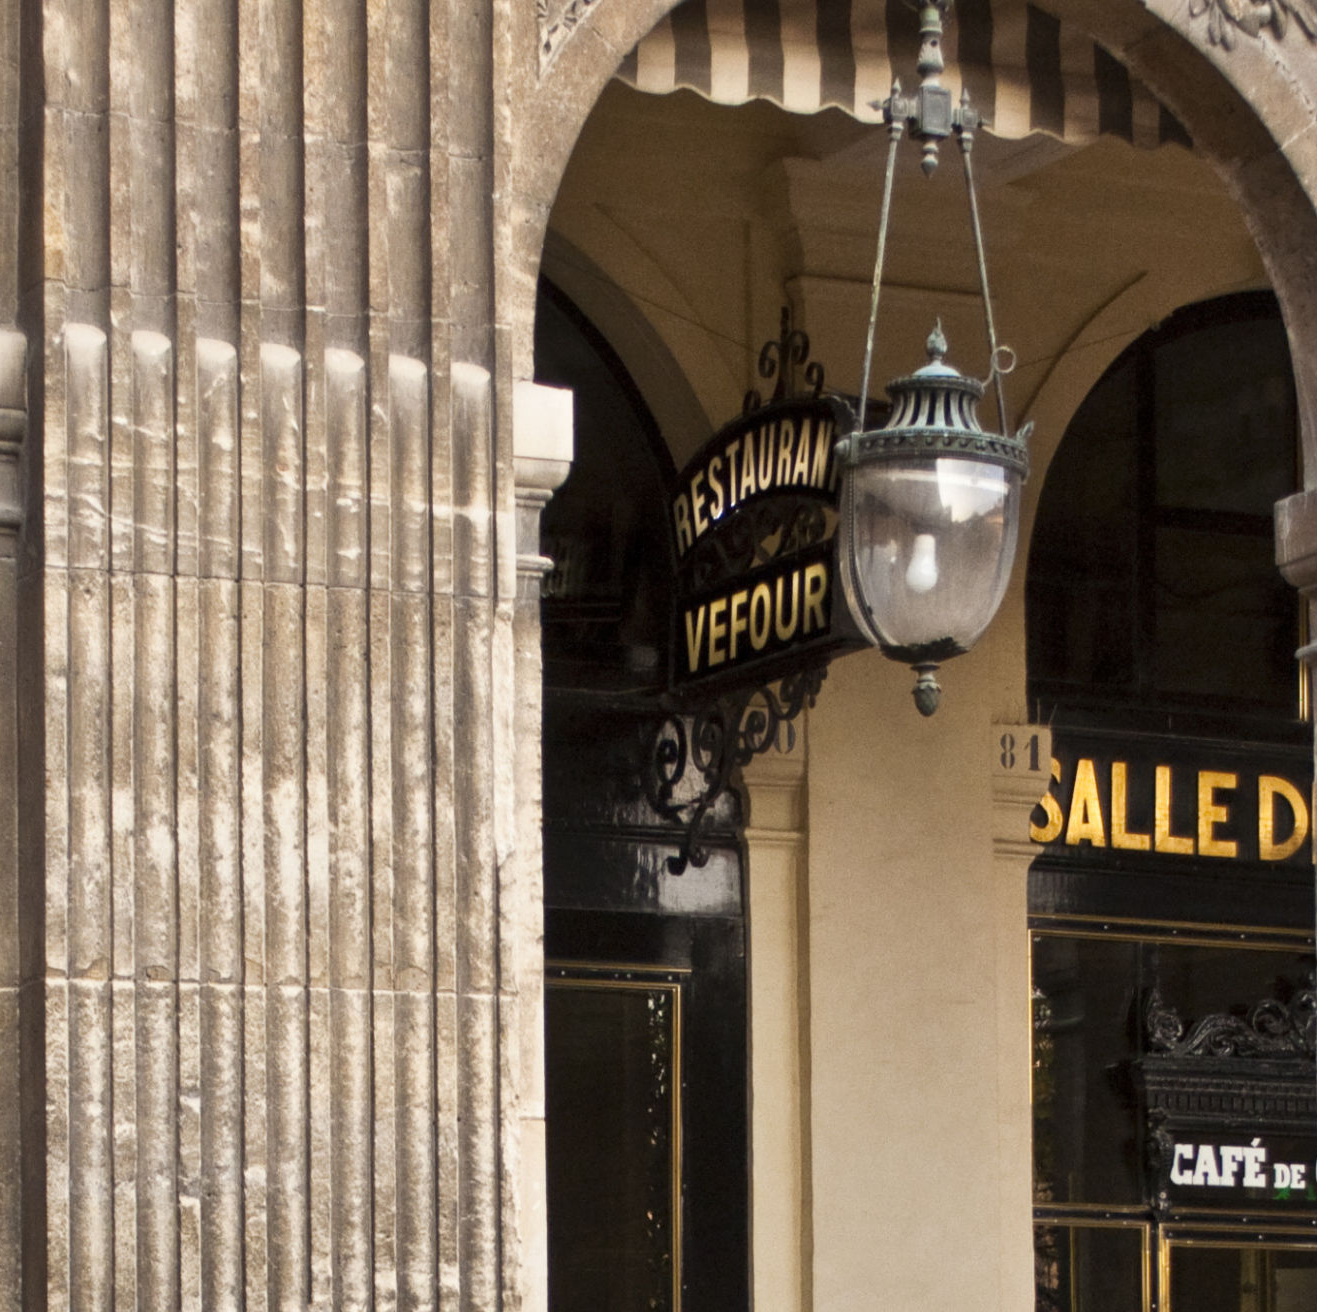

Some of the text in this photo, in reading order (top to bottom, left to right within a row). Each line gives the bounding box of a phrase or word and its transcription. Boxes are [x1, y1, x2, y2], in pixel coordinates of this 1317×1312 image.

[685, 562, 829, 675] VEFOUR
[1000, 733, 1041, 771] 81
[1029, 757, 1317, 865] SALLE D
[1170, 1137, 1266, 1188] CAFÉ
[1273, 1163, 1306, 1189] DE
